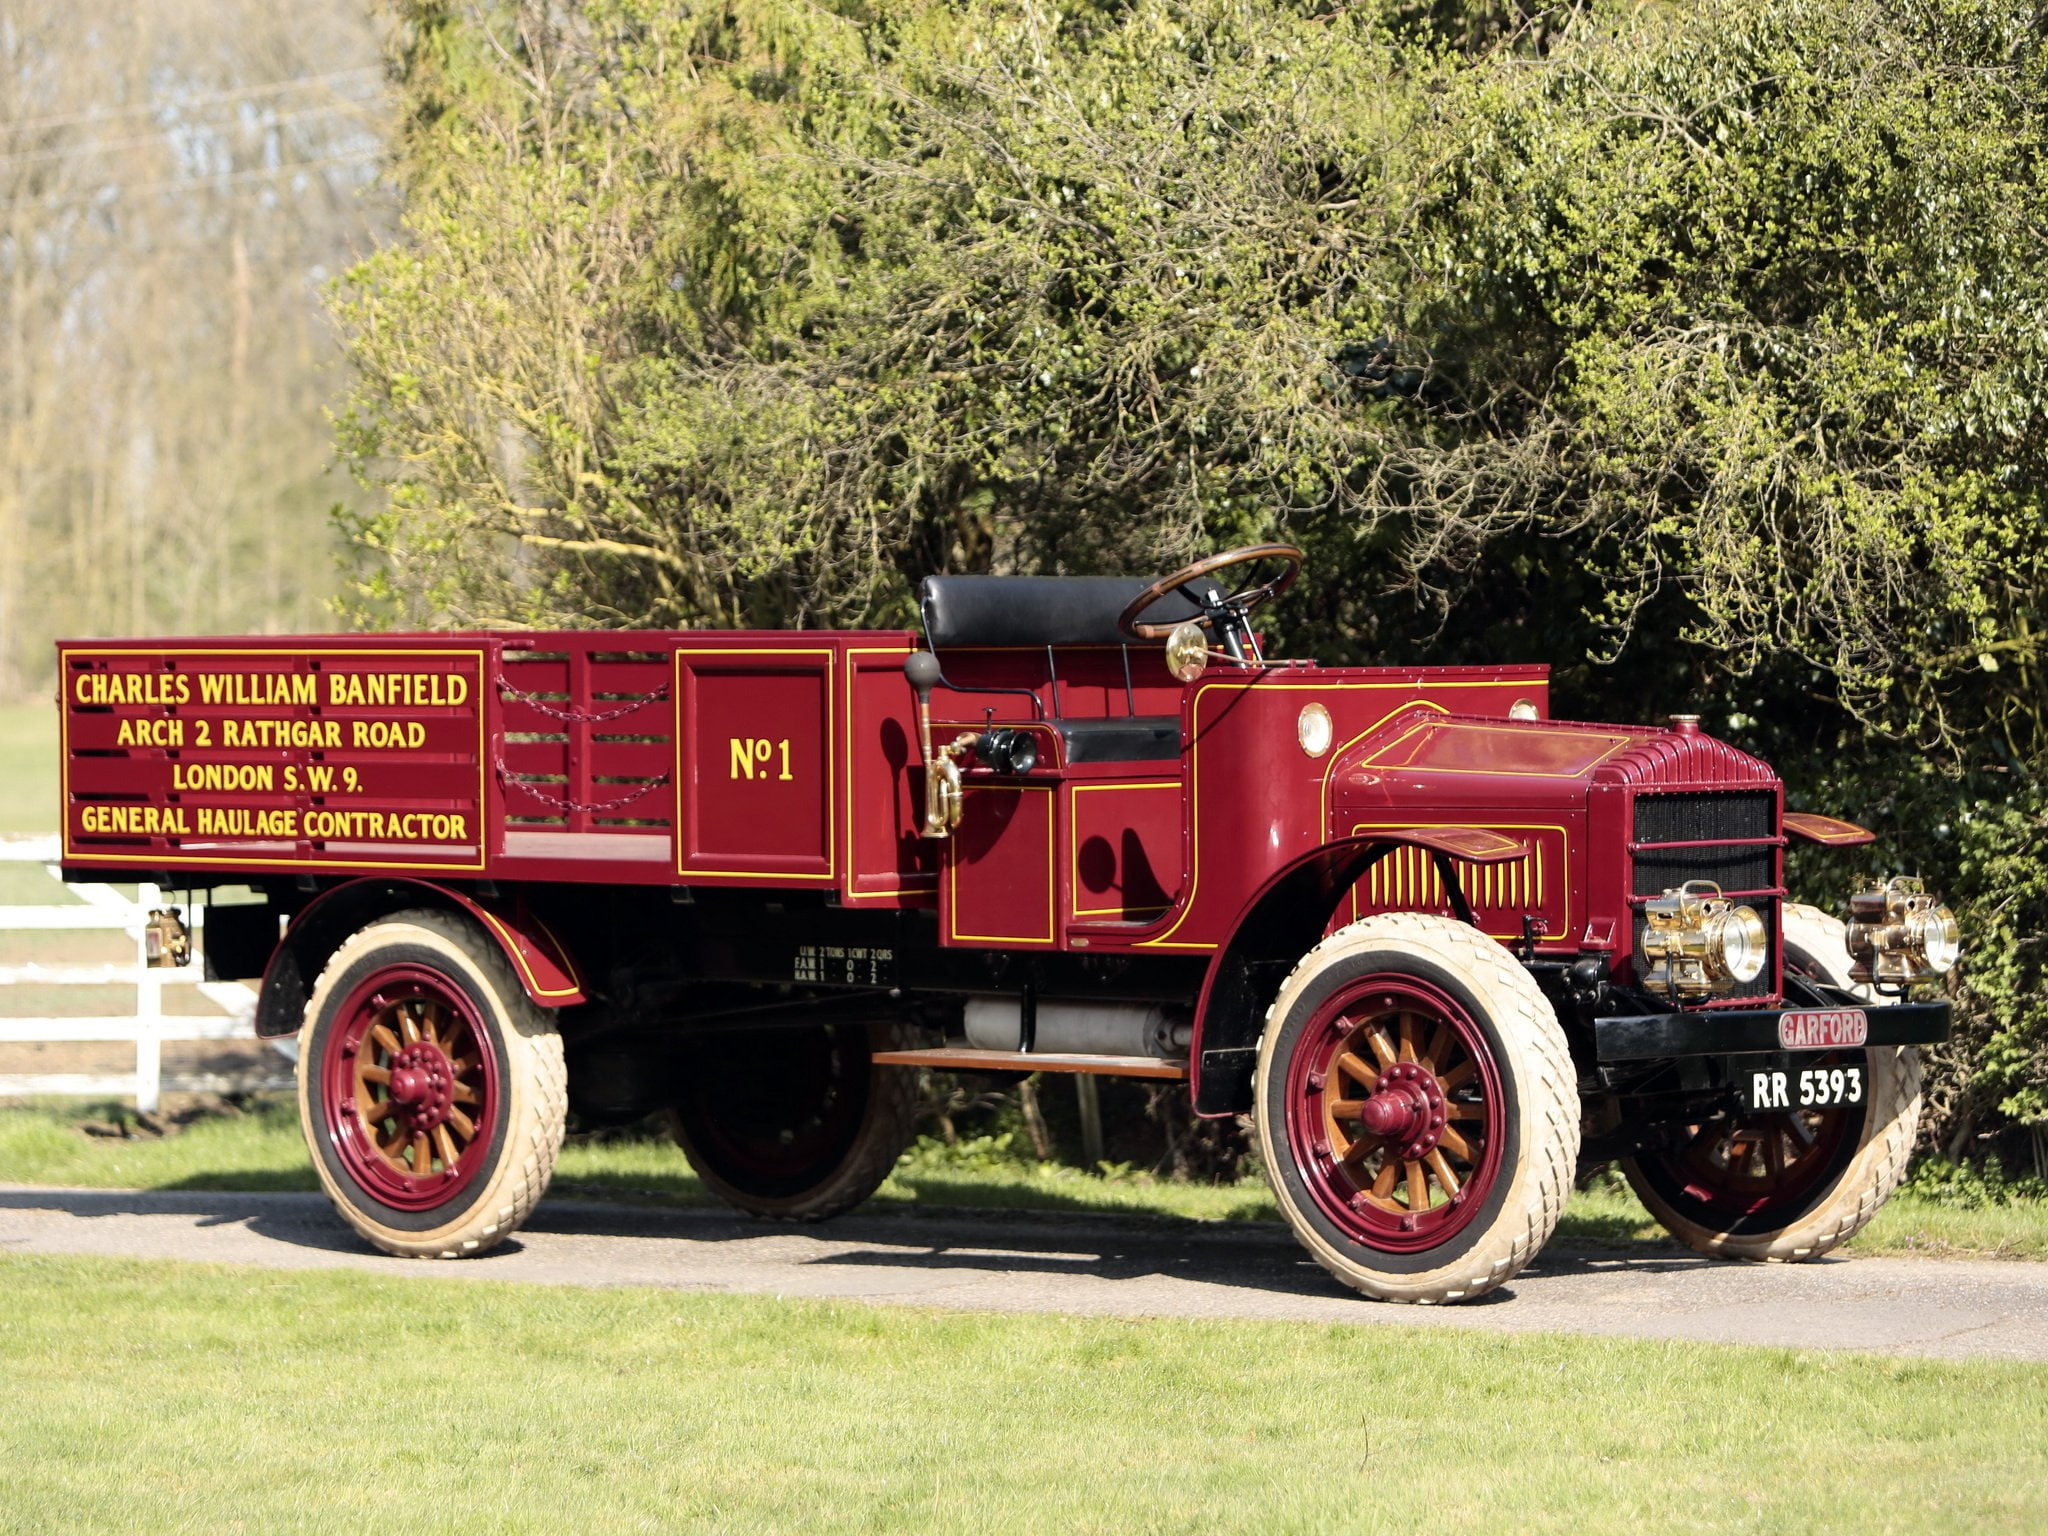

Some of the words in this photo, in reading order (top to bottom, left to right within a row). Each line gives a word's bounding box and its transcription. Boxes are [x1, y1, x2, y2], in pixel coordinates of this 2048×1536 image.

[75, 673, 190, 704] CHARLES
[199, 674, 317, 705] WILLIAM
[329, 674, 468, 706] BANFIELD
[117, 719, 184, 746] ARCH
[195, 720, 212, 747] 2
[223, 720, 343, 748] RATHGAR
[352, 721, 426, 748] ROAD
[173, 764, 273, 790] LONDON
[81, 806, 191, 834] GENERAL
[197, 809, 299, 836] HAULAGE
[303, 811, 468, 839] CONTRACTOR
[1781, 1013, 1866, 1046] GARFORD
[1753, 1072, 1789, 1109] RR
[1799, 1068, 1862, 1106] 5393
